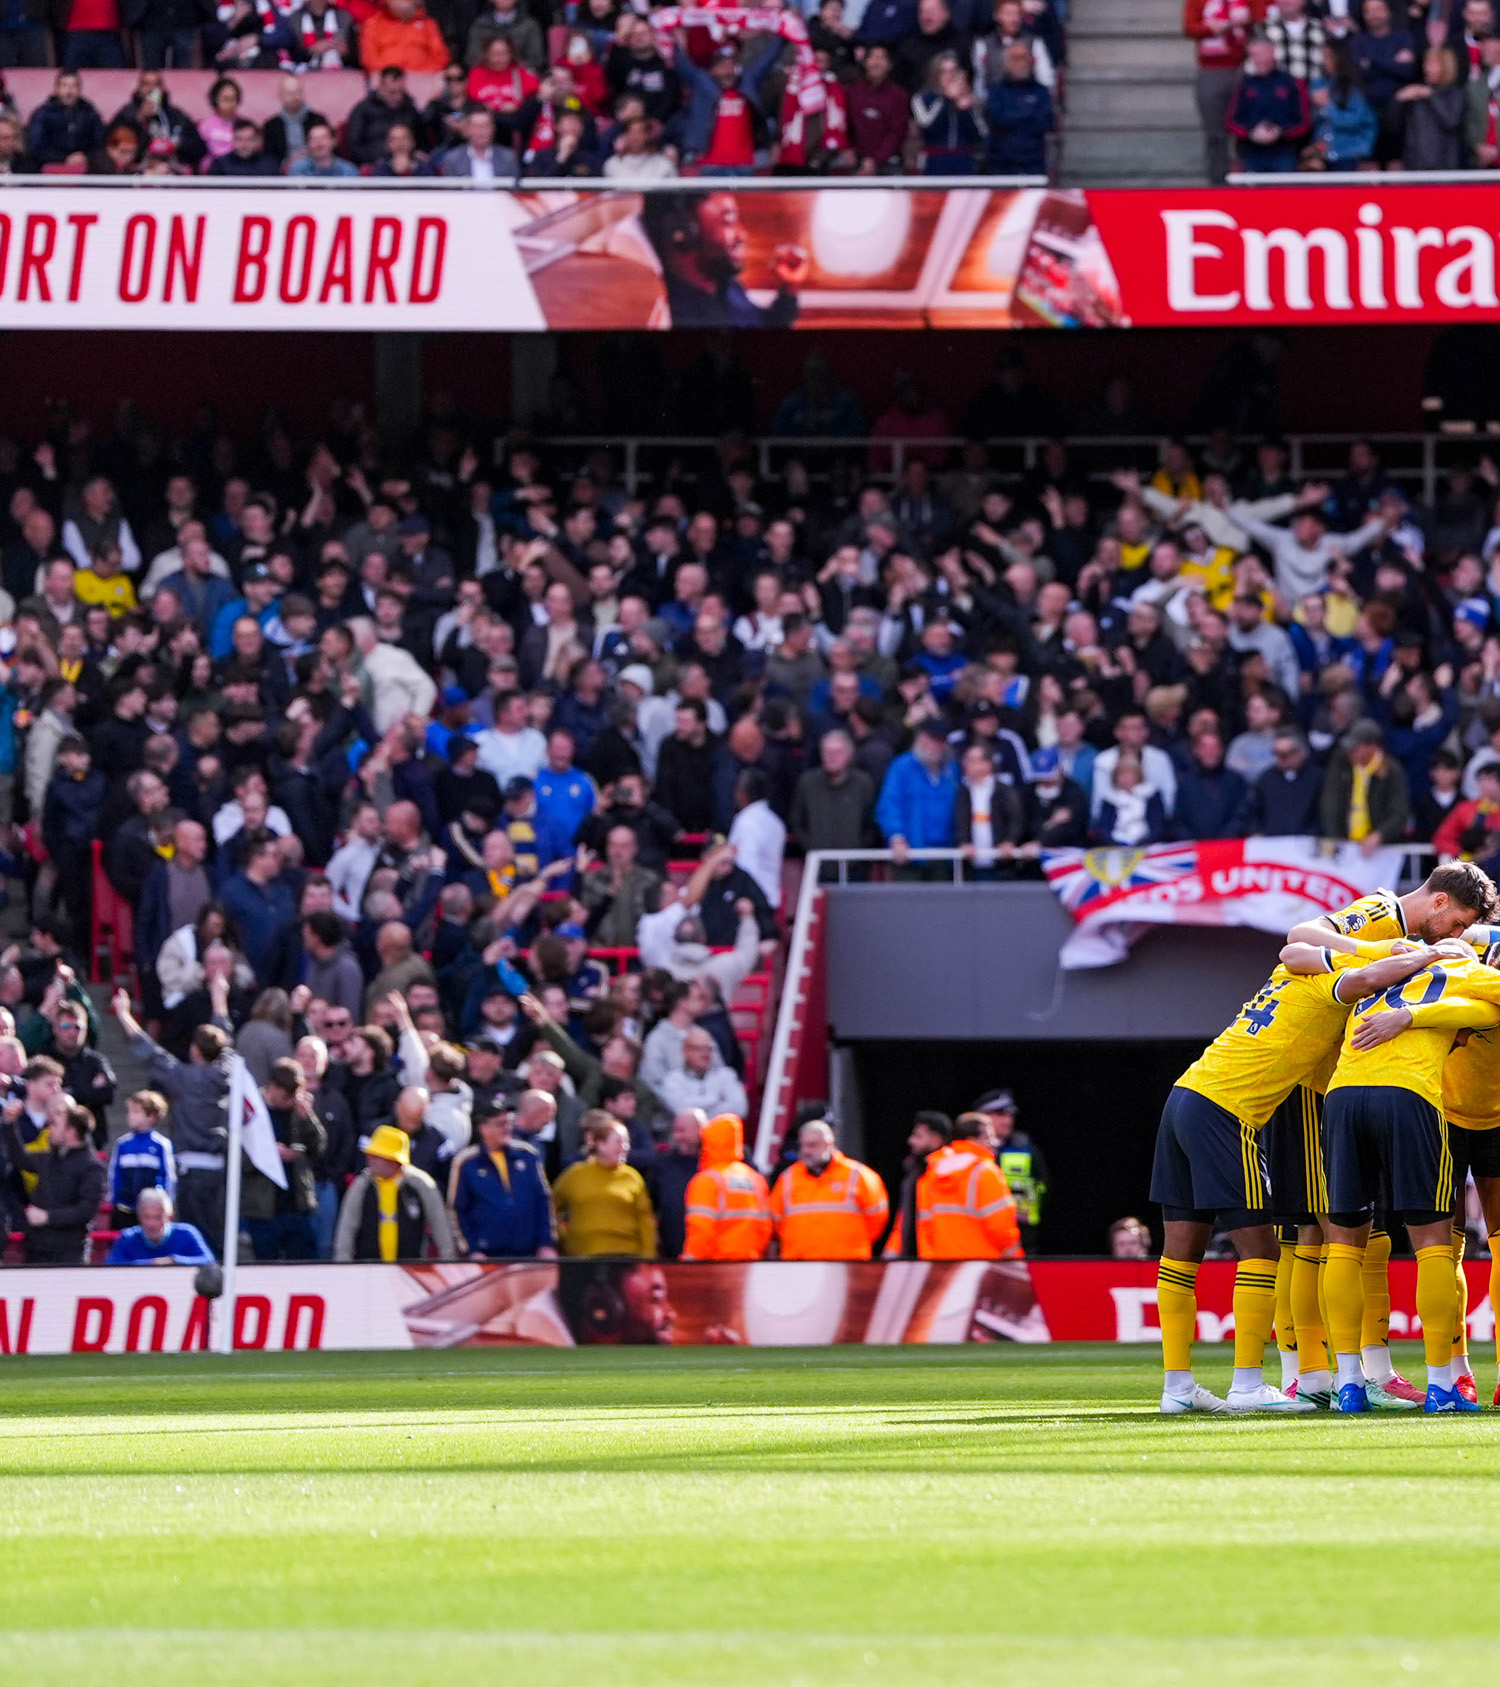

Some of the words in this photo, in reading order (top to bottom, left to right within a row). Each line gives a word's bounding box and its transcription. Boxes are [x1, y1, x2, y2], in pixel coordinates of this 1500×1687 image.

[119, 213, 206, 304] ON
[234, 214, 449, 305] BOARD
[1210, 864, 1356, 913] UNITED
